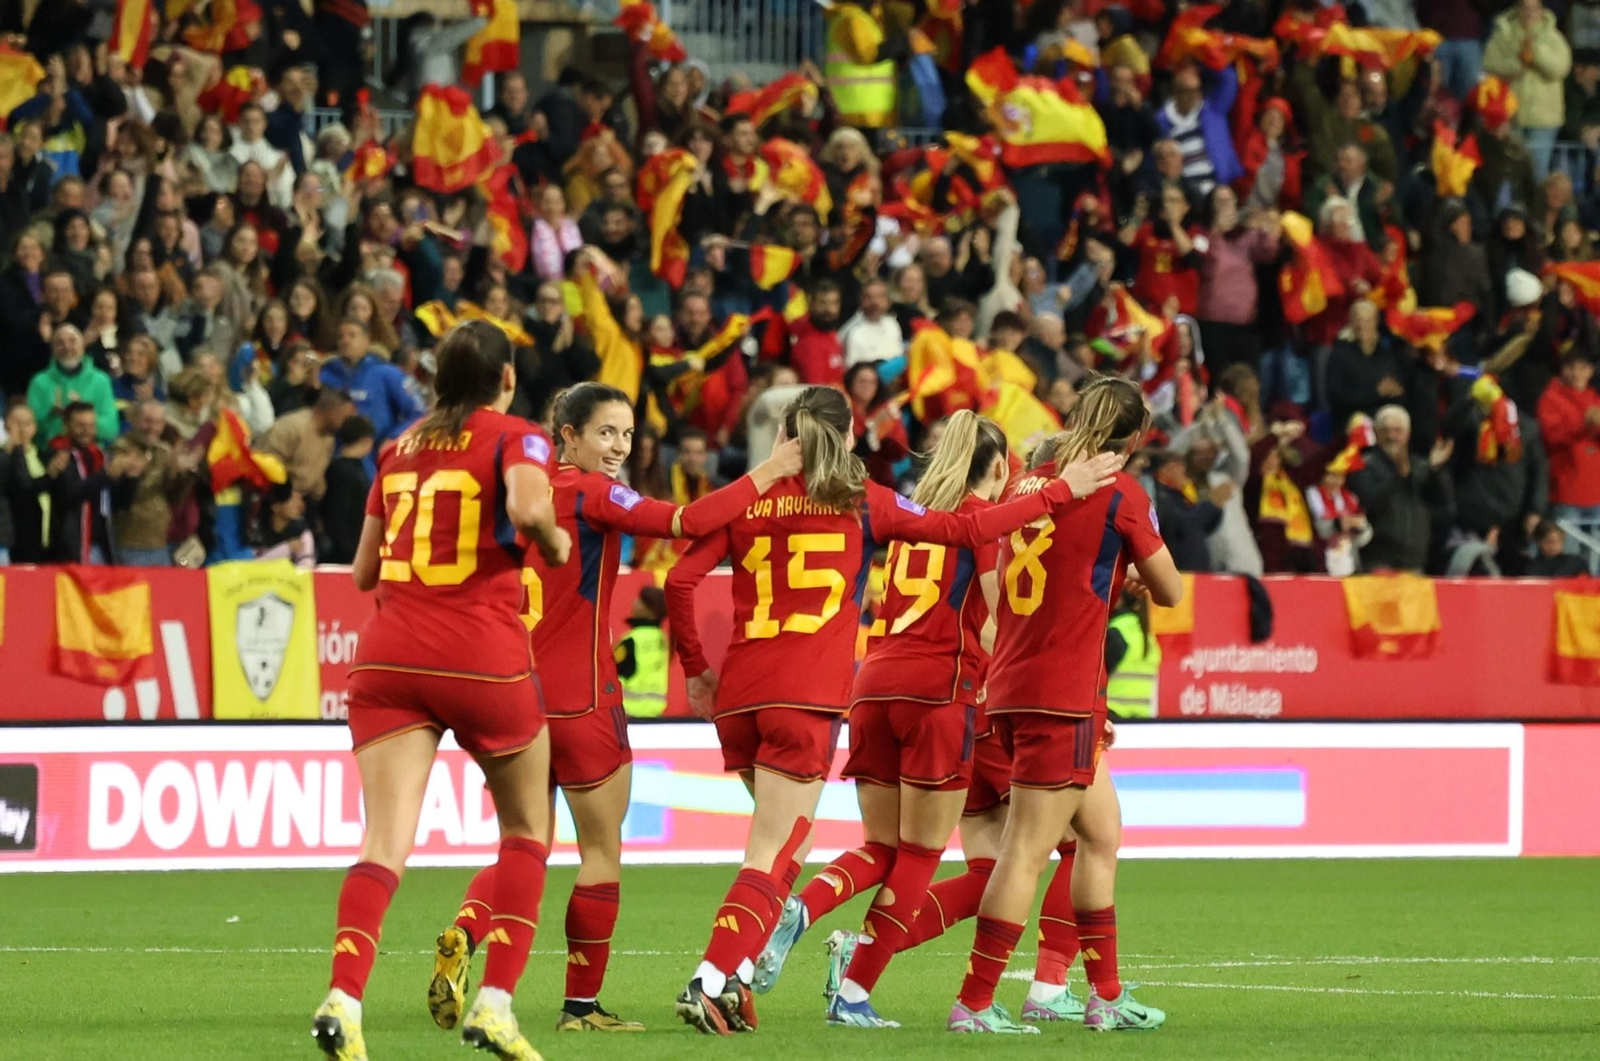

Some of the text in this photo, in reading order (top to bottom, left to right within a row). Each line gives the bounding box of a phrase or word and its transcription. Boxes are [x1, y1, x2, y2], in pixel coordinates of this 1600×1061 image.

[379, 468, 482, 586] 20
[1005, 513, 1056, 616] 8
[741, 533, 846, 640] 15
[318, 620, 359, 665] ión
[1180, 684, 1283, 718] de Málaga
[88, 759, 500, 850] DOWNLAD
